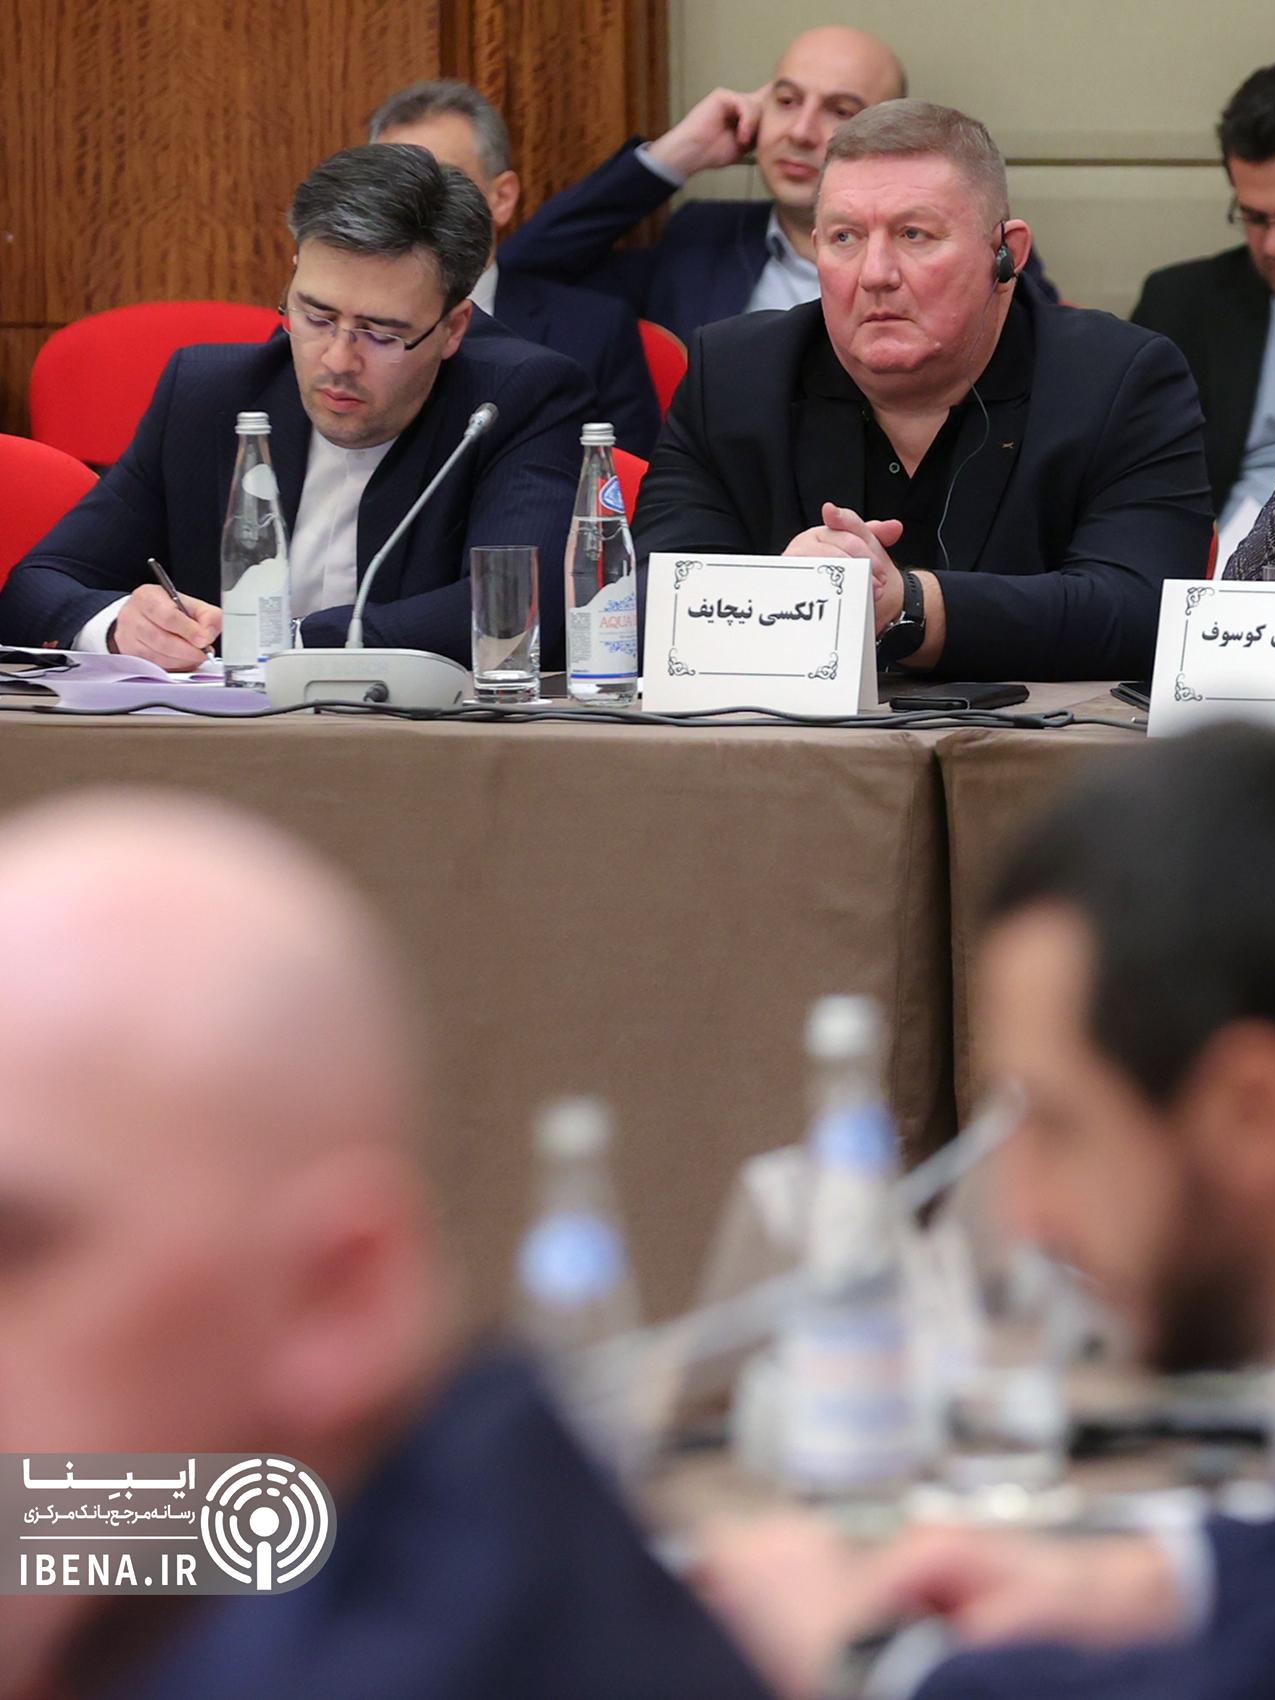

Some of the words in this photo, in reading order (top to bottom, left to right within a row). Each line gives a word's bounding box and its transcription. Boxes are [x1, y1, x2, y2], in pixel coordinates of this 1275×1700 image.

[687, 598, 753, 626] نیچایف
[759, 599, 828, 626] آلکسی
[1201, 621, 1267, 648] کوسوف
